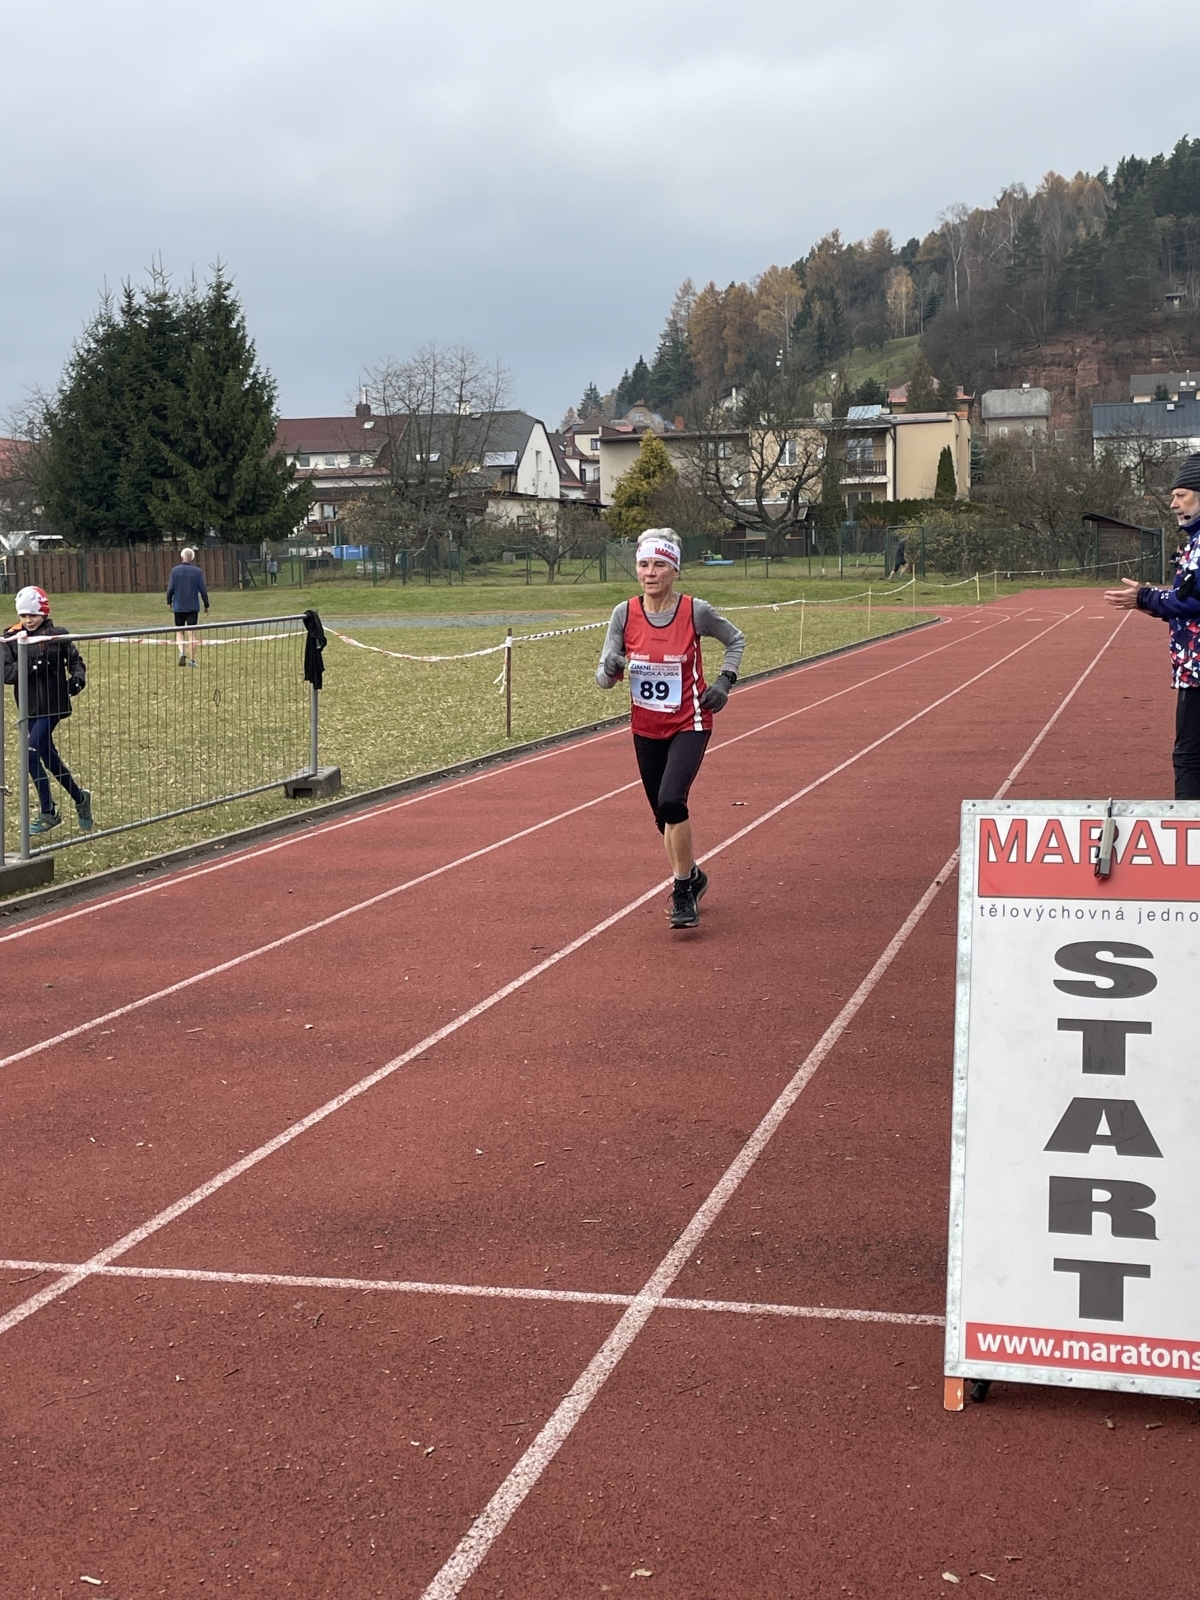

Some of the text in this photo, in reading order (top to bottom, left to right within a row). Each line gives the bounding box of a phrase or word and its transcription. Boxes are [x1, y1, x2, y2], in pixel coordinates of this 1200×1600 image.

[640, 681, 670, 701] 89
[979, 904, 1200, 924] tělovýchovná jedno
[1043, 940, 1164, 1322] START
